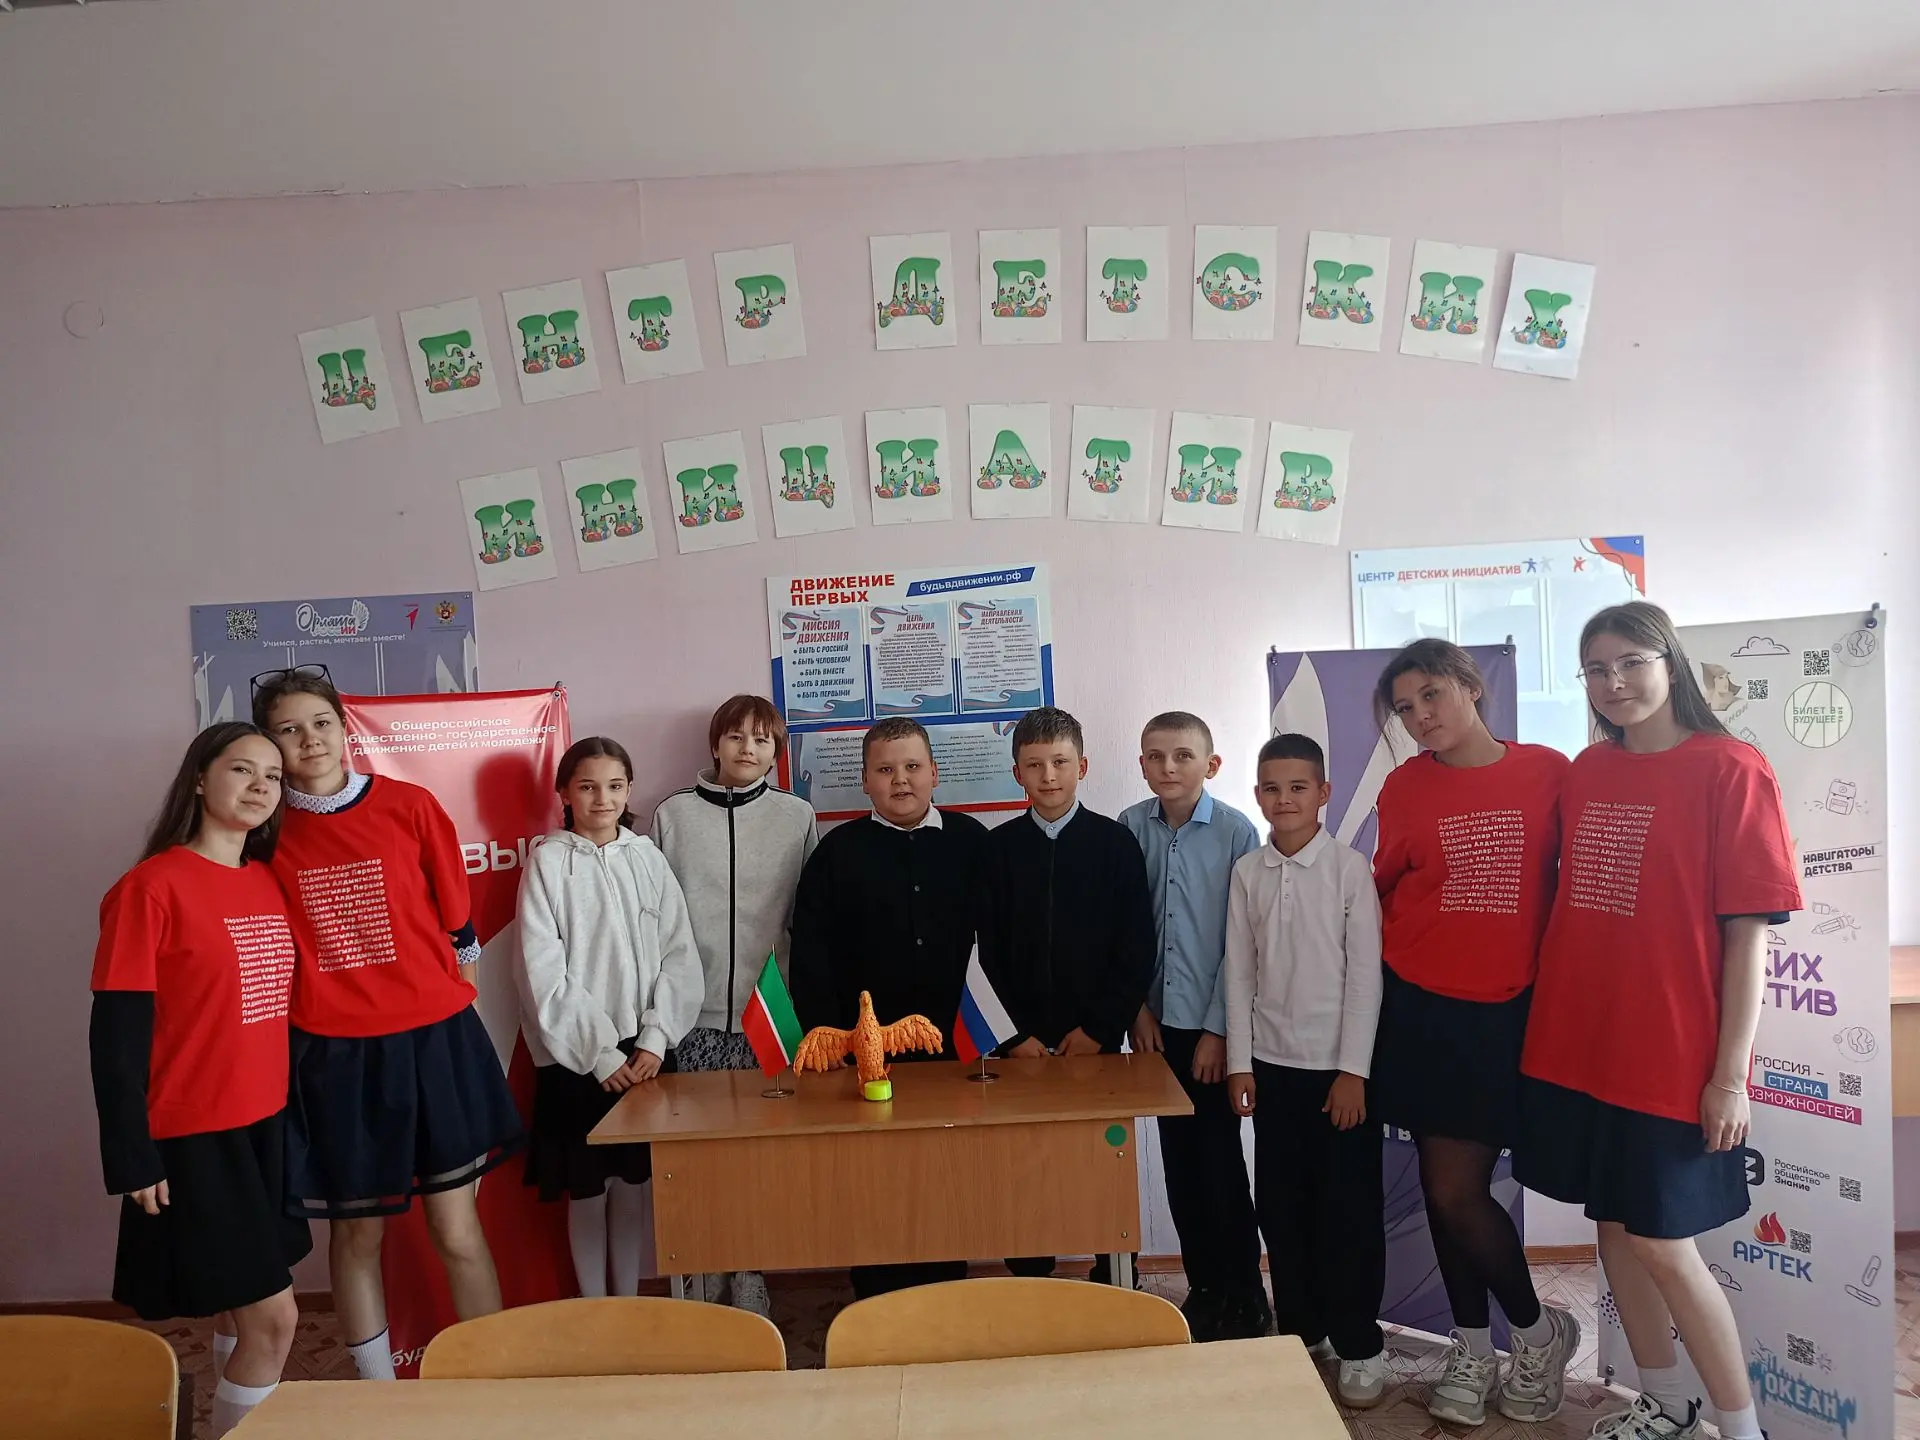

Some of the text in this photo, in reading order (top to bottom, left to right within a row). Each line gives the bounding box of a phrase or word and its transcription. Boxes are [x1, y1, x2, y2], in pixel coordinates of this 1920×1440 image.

[318, 253, 1572, 410] ЦЕНТР ДЕТСКИХ
[475, 430, 1335, 564] ИНИЦИАТИВ
[790, 571, 1022, 594] ДВИЖЕНИЕ будьвдвижении.рф
[1358, 565, 1521, 583] ЦЕНТР ДЕТСКИХ ИНИЦИАТИВ
[791, 590, 869, 607] ПЕРВЫХ
[802, 619, 840, 632] МИССИЯ
[897, 622, 935, 633] ДВИЖЕНИЯ
[906, 614, 923, 624] ЦЕЛЬ
[797, 631, 849, 645] ДВИЖЕНИЯ
[798, 646, 815, 655] БЫТЬ
[817, 655, 851, 665] ЧЕЛОВЕКОМ
[805, 667, 845, 677] БЫТЬ ВМЕСТЕ
[1793, 706, 1825, 715] БИЛЕТ
[391, 717, 511, 731] Общероссийское
[1793, 715, 1836, 724] БУДУЩЕЕ
[447, 725, 557, 740] государственное
[353, 744, 425, 757] движение
[428, 740, 468, 752] детей
[470, 740, 479, 748] и
[1803, 846, 1875, 864] НАВИГАТОРЫ
[1804, 861, 1852, 877] ДЕТСТВА
[1766, 949, 1823, 983] ИХ
[1762, 982, 1838, 1017] ТИВ
[1754, 1054, 1811, 1076] РОССИЯ
[1768, 1075, 1824, 1097] СТРАНА
[1748, 1087, 1855, 1121] ОЗМОЖНОСТЕЙ
[1774, 1158, 1830, 1180] Российское
[1774, 1168, 1820, 1186] общество
[1774, 1176, 1810, 1192] Знание
[1733, 1240, 1813, 1282] АРТЕК
